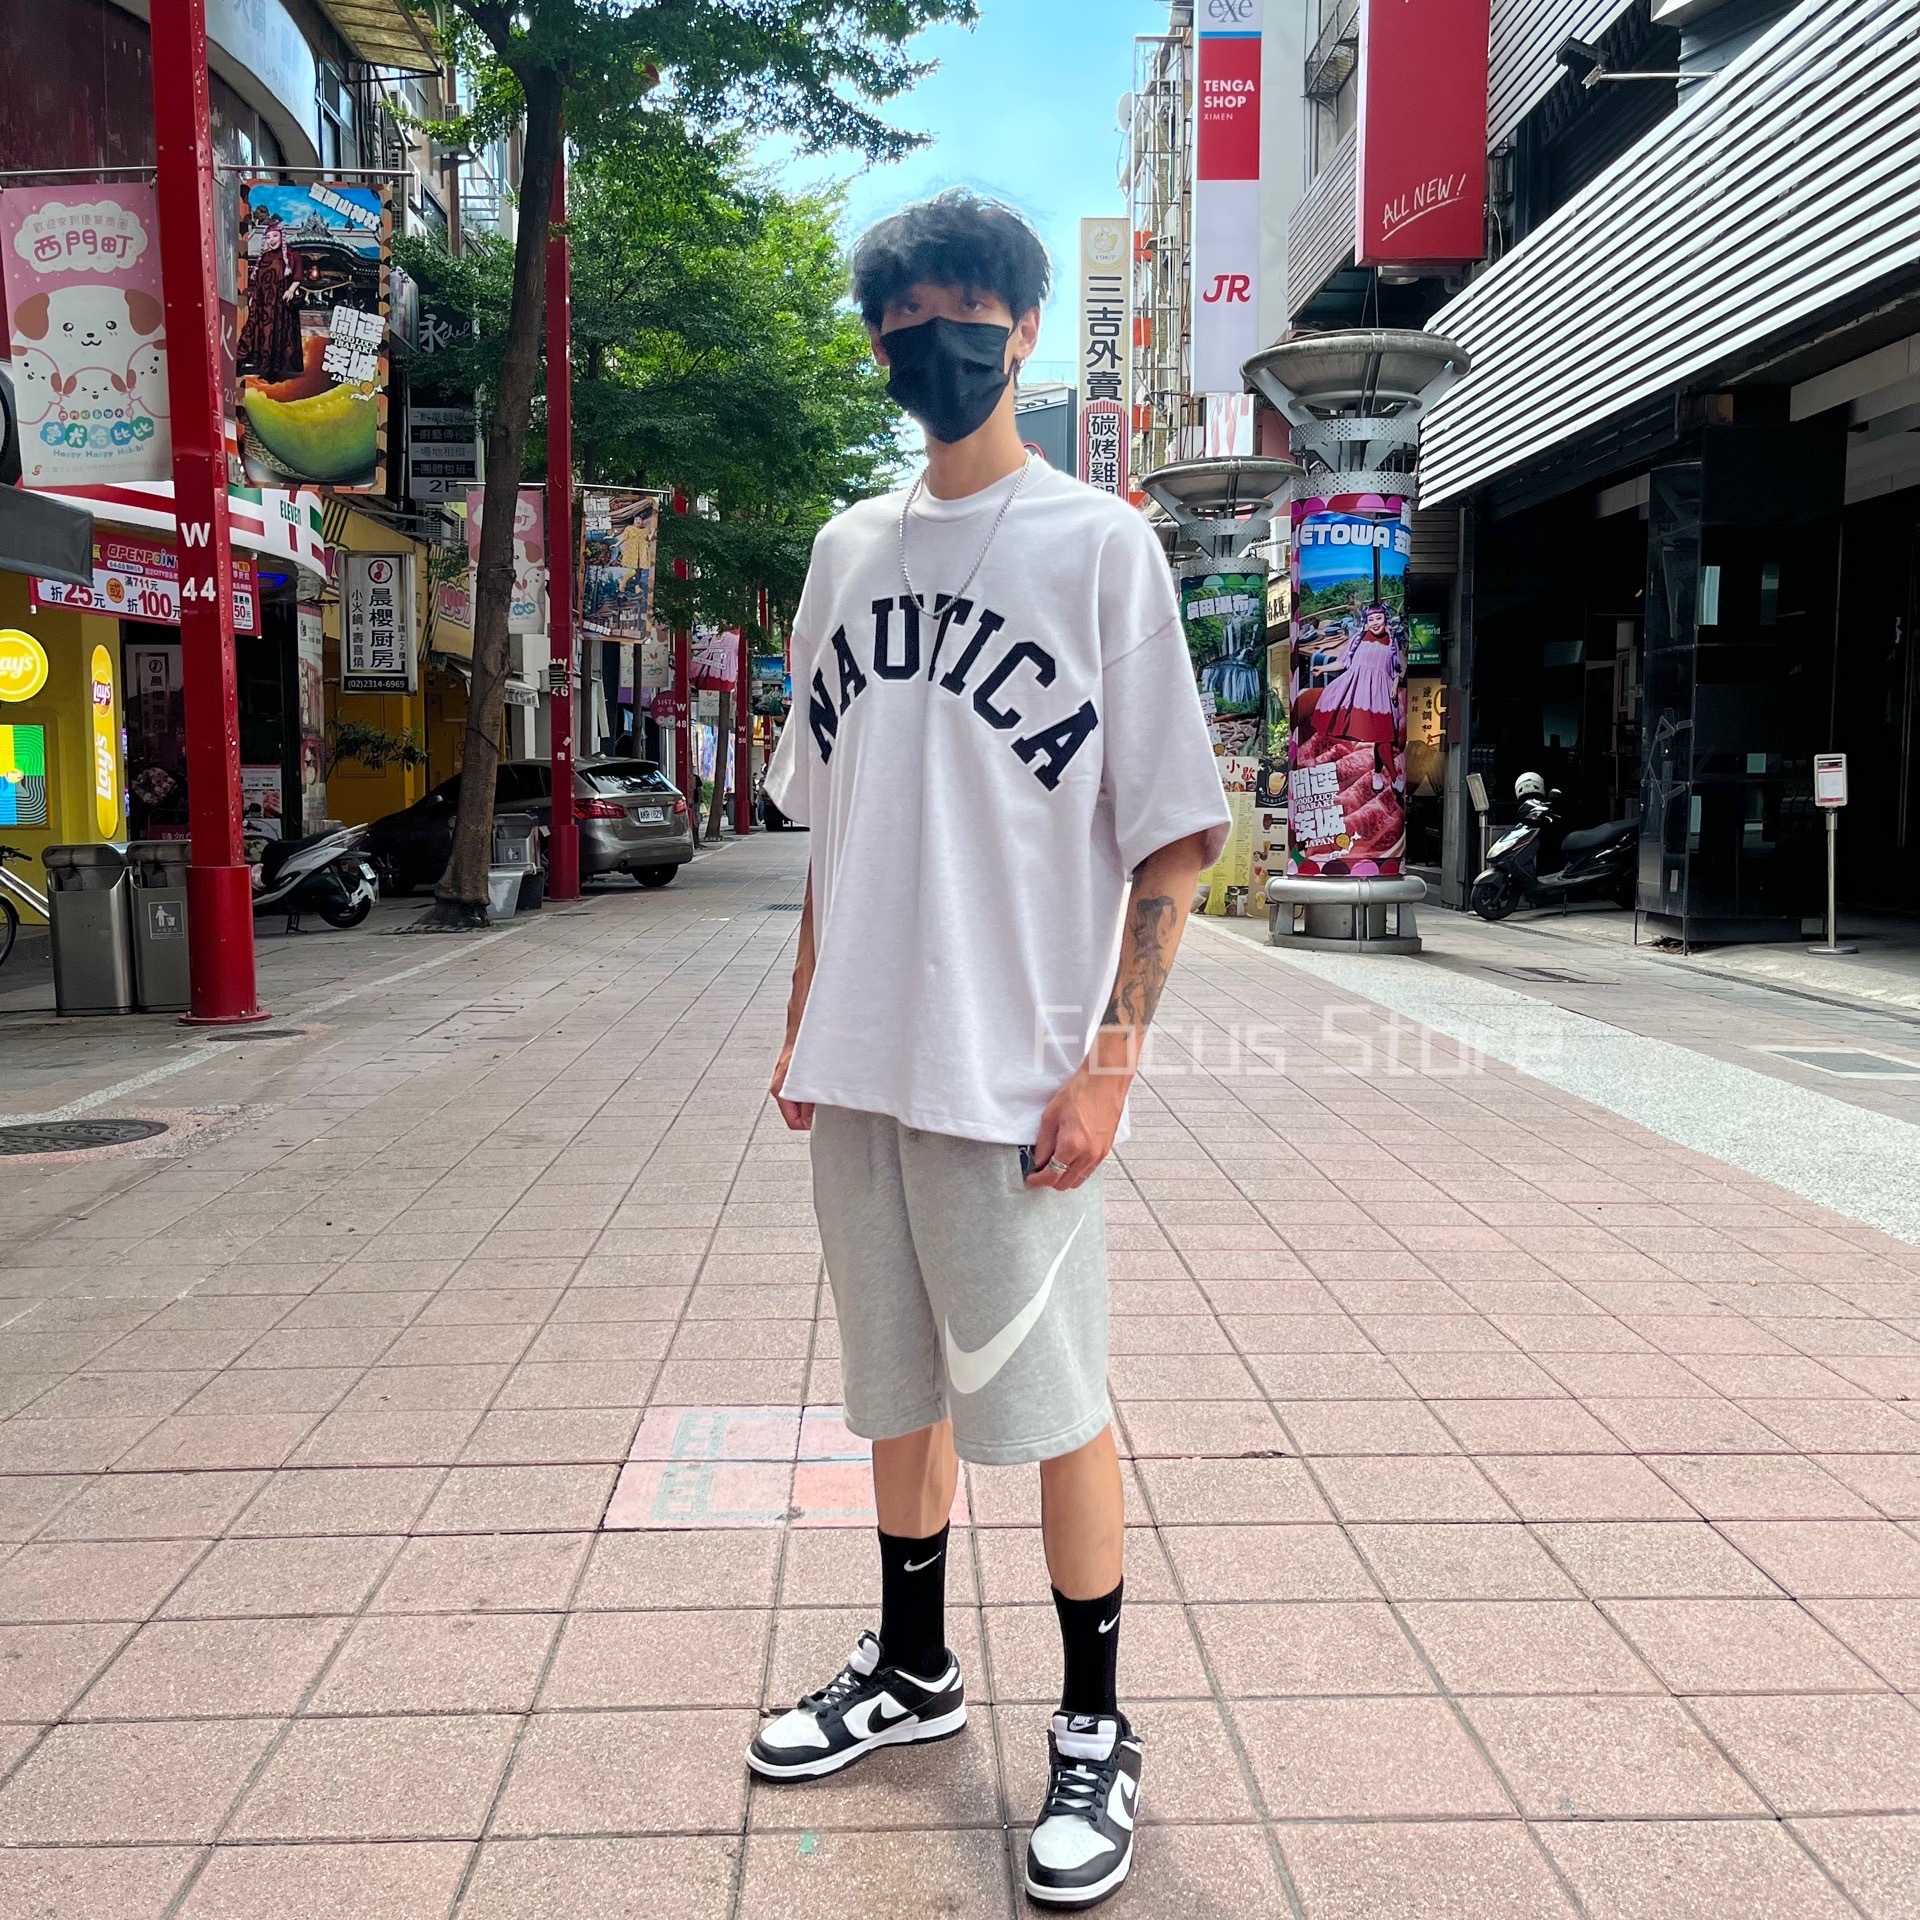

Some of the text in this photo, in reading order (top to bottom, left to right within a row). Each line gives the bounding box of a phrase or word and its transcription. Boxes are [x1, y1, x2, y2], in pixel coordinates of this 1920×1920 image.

[1203, 79, 1255, 92] TENGA
[1203, 95, 1247, 108] SHOP
[1203, 112, 1234, 121] XIMEN
[1382, 194, 1410, 230] ALL
[33, 228, 134, 263] 西門町
[1202, 274, 1251, 303] JR
[330, 332, 379, 350] GOOD LUCK
[419, 313, 447, 353] 永
[1085, 275, 1124, 402] 三吉外賣
[334, 339, 374, 355] IBARAKI
[330, 373, 361, 387] JAPAN
[53, 449, 81, 458] Happy
[86, 450, 114, 458] Happy
[429, 479, 459, 493] 2F
[180, 521, 211, 548] W
[109, 583, 122, 599] 或
[125, 575, 159, 592] 滿711元
[182, 576, 217, 602] 44
[0, 653, 34, 679] ay's
[347, 679, 405, 690] (02)2314-6969
[808, 593, 1099, 792] NAUTICA
[93, 681, 112, 706] Lay's
[676, 703, 687, 712] W
[676, 720, 687, 728] 48
[95, 733, 114, 801] Lay's
[1314, 791, 1339, 803] LUCK
[1297, 799, 1336, 813] IBARAKI
[1304, 836, 1335, 849] JAPAN
[1074, 1714, 1092, 1725] NIKE
